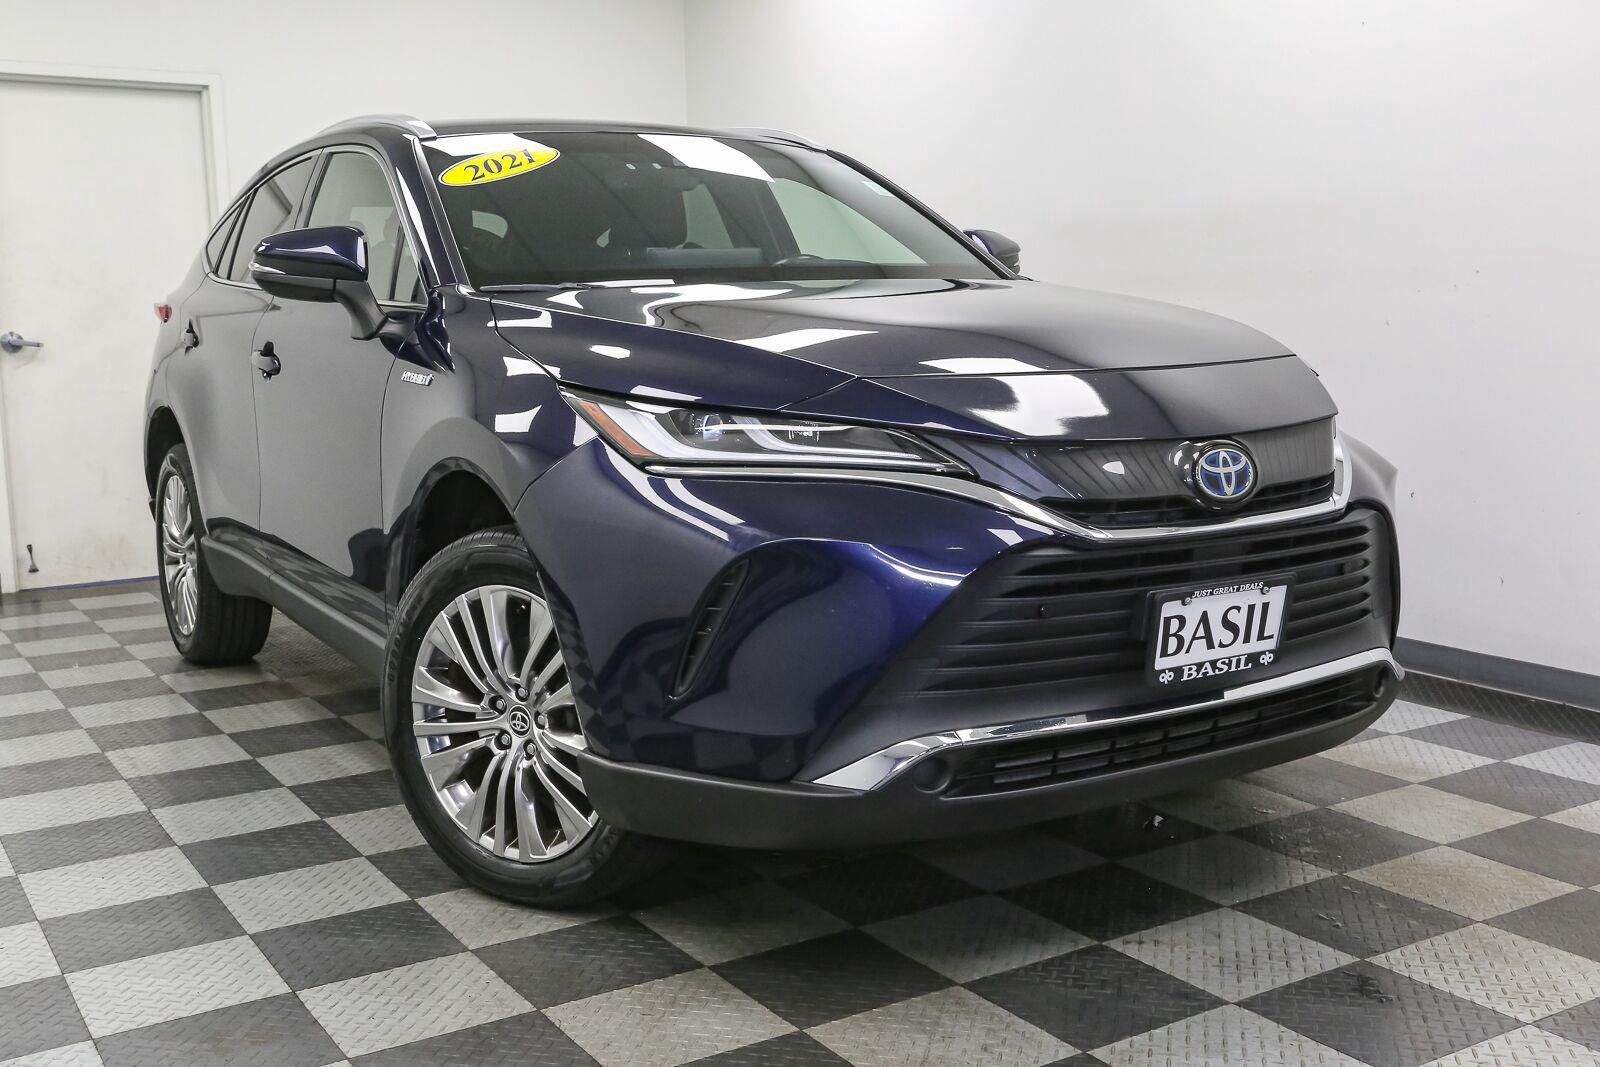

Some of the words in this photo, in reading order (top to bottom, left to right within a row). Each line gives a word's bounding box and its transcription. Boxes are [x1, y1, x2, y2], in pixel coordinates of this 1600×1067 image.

[464, 149, 535, 181] 2021
[1192, 589, 1212, 598] JUST
[1213, 585, 1239, 595] GREAT
[1240, 582, 1264, 591] DEALS
[1160, 601, 1274, 658] BASIL
[1180, 655, 1252, 681] BASIL
